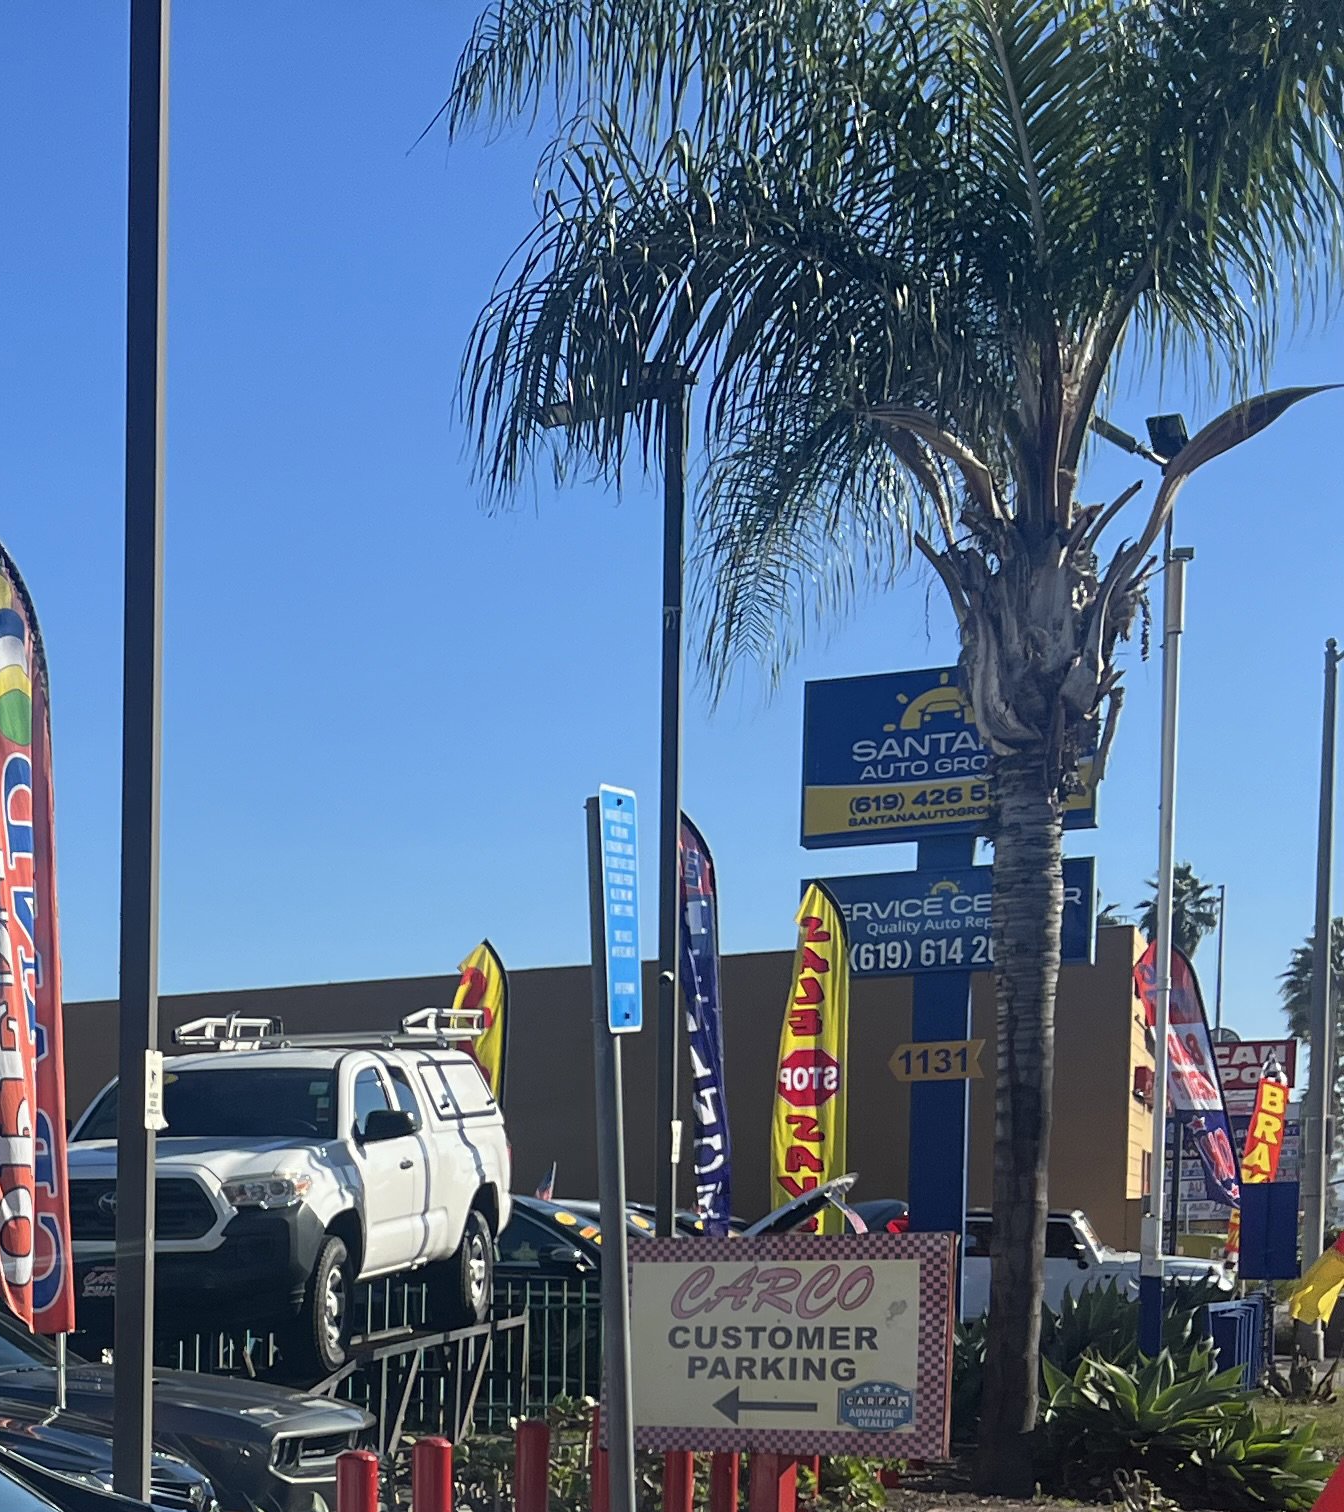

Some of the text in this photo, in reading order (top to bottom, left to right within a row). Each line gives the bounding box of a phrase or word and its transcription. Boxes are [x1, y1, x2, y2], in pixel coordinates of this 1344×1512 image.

[852, 731, 985, 762] SANTA
[860, 754, 990, 780] AUTO GRO
[850, 792, 904, 815] (619)
[912, 787, 962, 807] 426
[848, 805, 989, 827] SANTANAAUTOGRO
[843, 898, 943, 921] ERVICE
[866, 915, 992, 936] Quality Auto Rep
[851, 940, 912, 972] (619)
[920, 938, 963, 967] 614
[898, 1047, 968, 1075] 1131
[671, 1264, 875, 1320] CARCO
[668, 1326, 879, 1350] CUSTOMER
[687, 1356, 857, 1381] PARKING
[849, 1408, 904, 1419] ADVANTAGE
[857, 1419, 894, 1428] DEALER
